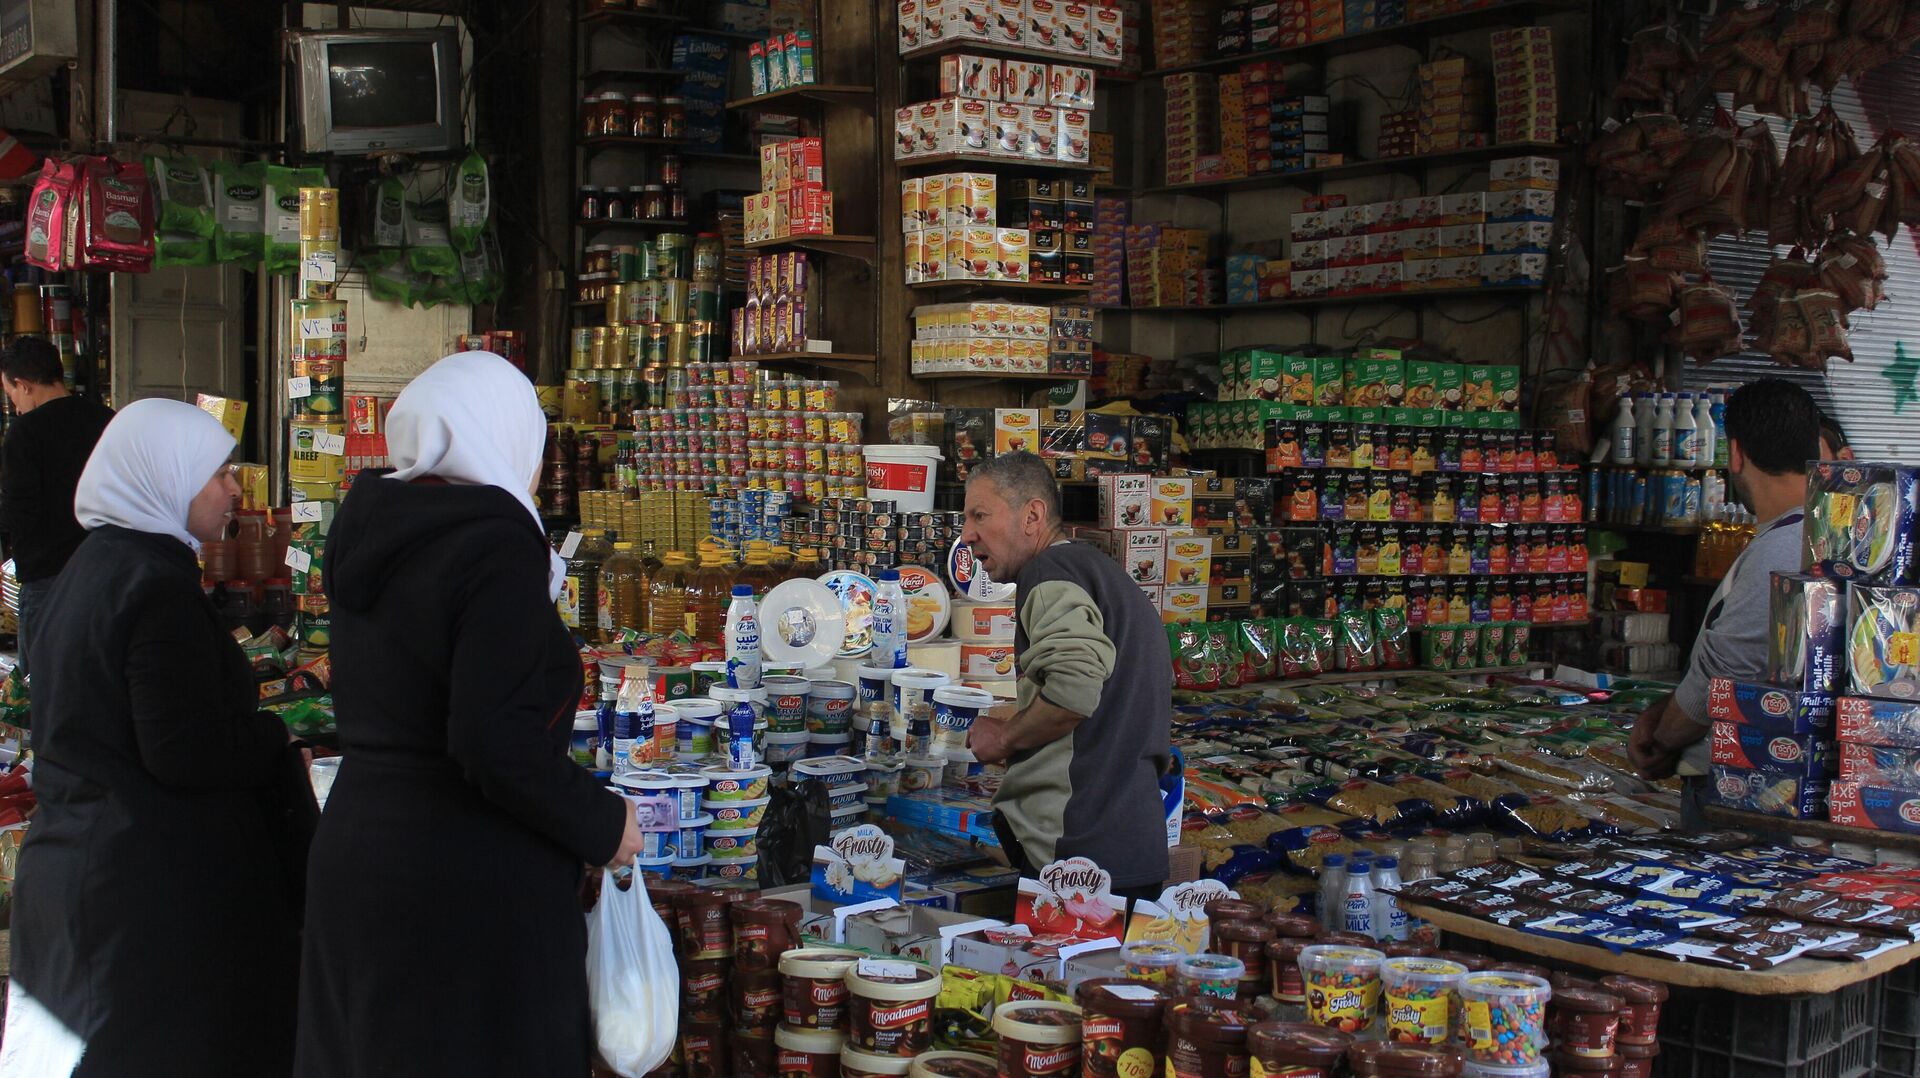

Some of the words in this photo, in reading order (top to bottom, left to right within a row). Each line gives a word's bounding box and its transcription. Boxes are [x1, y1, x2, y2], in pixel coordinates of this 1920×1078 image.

[105, 191, 139, 204] Basmati
[293, 449, 319, 461] ALREEF
[866, 466, 887, 478] rosty
[1119, 480, 1125, 489] 2
[1133, 480, 1139, 489] 7
[1131, 535, 1138, 544] 2
[1146, 535, 1152, 544] 7
[736, 634, 759, 647] حليب
[860, 687, 878, 700] ODY
[1801, 696, 1835, 707] Full-Fa
[856, 828, 874, 838] MILK
[836, 835, 887, 860] Frosty
[1043, 866, 1103, 894] Frosty
[1346, 900, 1366, 910] Park
[960, 944, 968, 953] 12
[1066, 962, 1075, 972] 12
[871, 1000, 928, 1025] Moadamani
